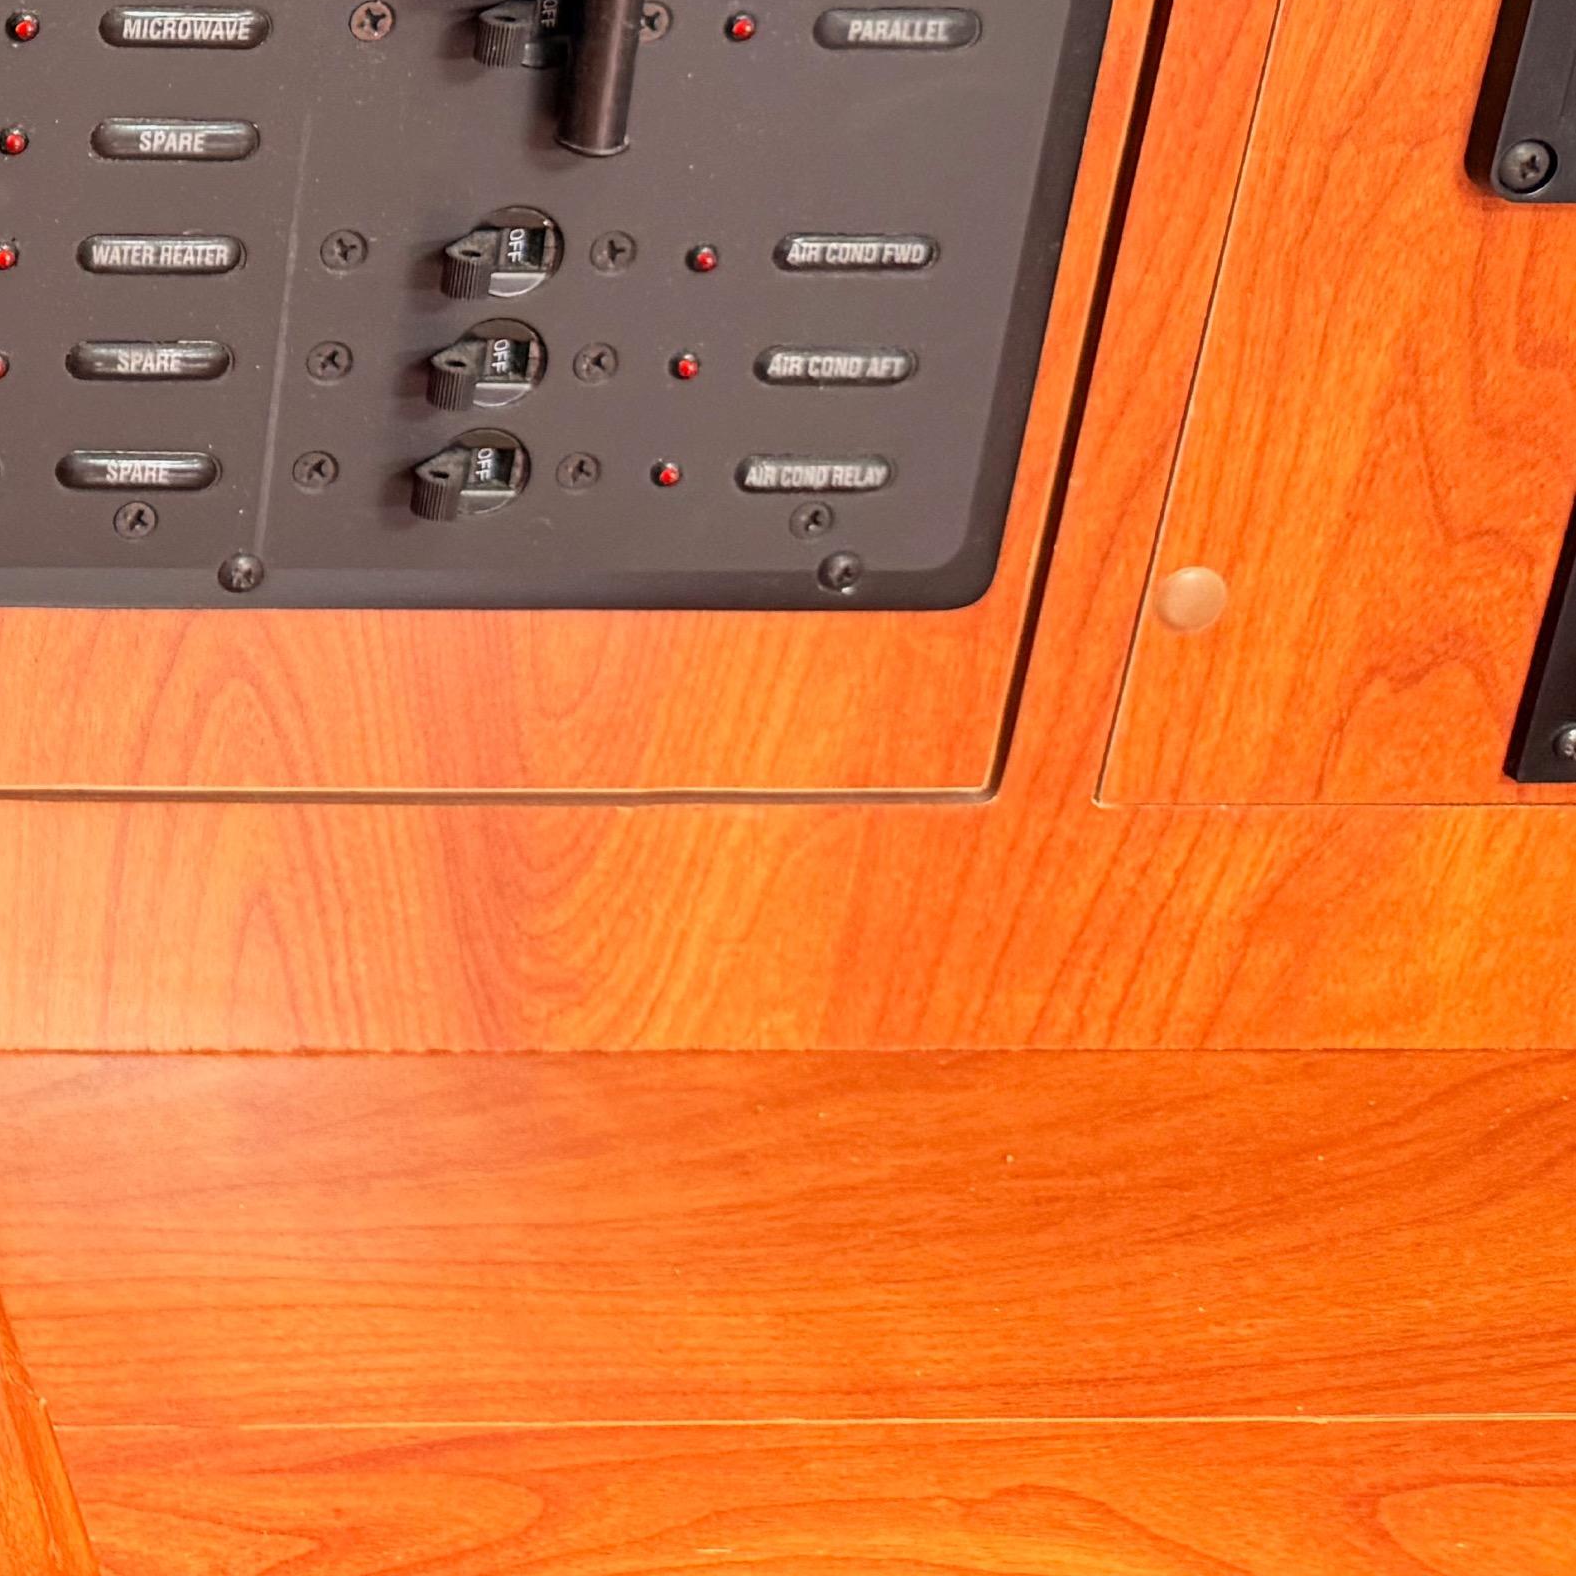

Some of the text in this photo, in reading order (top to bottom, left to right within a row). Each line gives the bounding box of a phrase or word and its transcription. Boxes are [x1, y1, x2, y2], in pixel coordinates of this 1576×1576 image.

[122, 18, 251, 41] MICROWAVE
[847, 19, 948, 41] PARALLEL
[139, 131, 205, 153] SPARE
[92, 244, 229, 266] WATER HEATER
[507, 228, 525, 263] OFF
[787, 243, 925, 264] AIR COND FWD
[116, 352, 183, 372] SPARE
[491, 339, 510, 374] OFF
[767, 356, 906, 377] AIR COND AFT
[105, 462, 170, 482] SPARE
[476, 448, 493, 482] OFF
[745, 465, 888, 487] AIR COND RELAY
